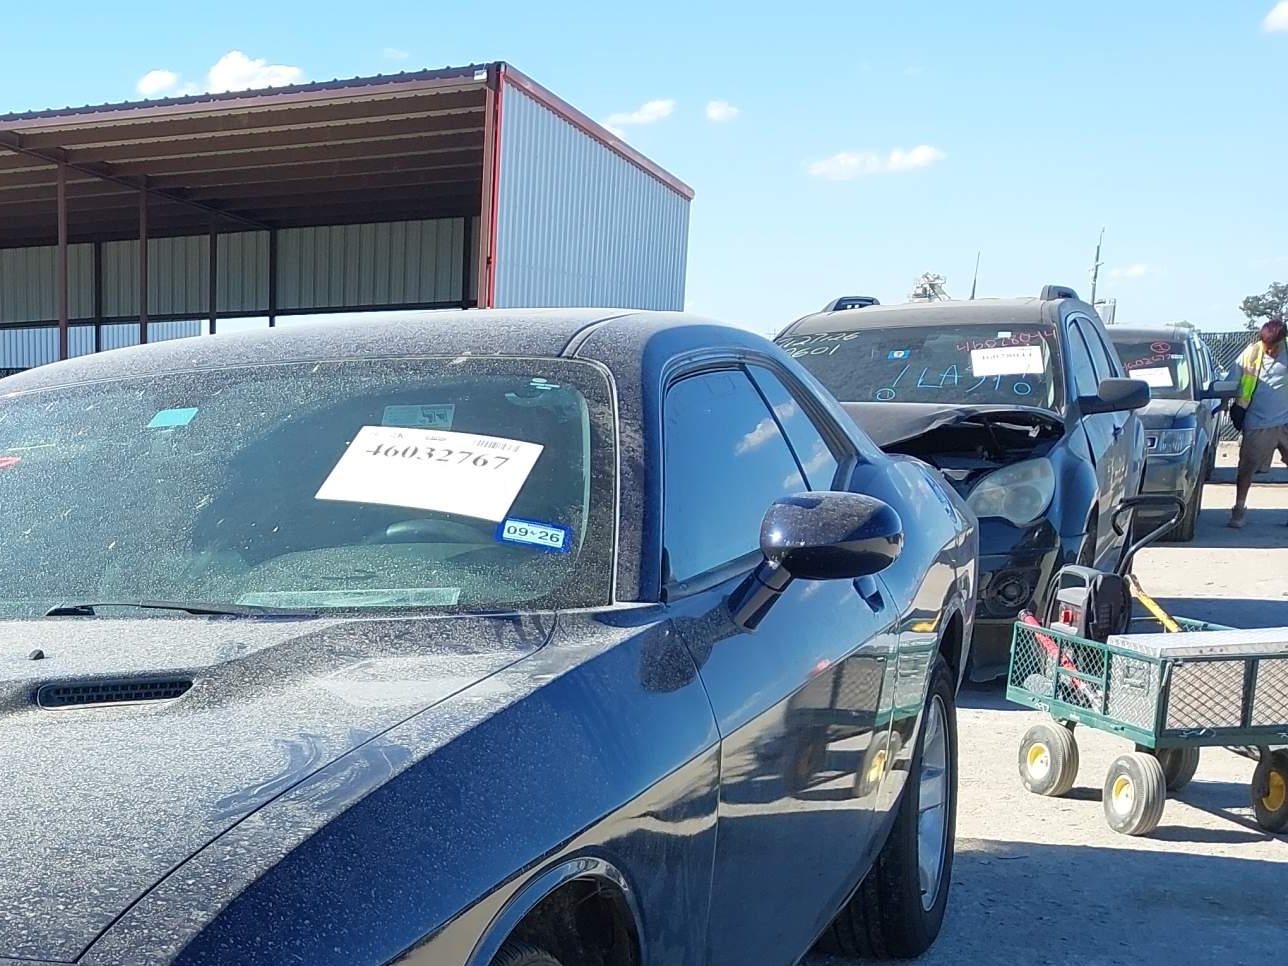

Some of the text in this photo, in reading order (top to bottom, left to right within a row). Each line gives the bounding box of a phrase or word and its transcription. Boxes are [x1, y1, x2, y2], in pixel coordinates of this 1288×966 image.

[365, 443, 510, 471] 46032767
[506, 524, 561, 543] 09 26
